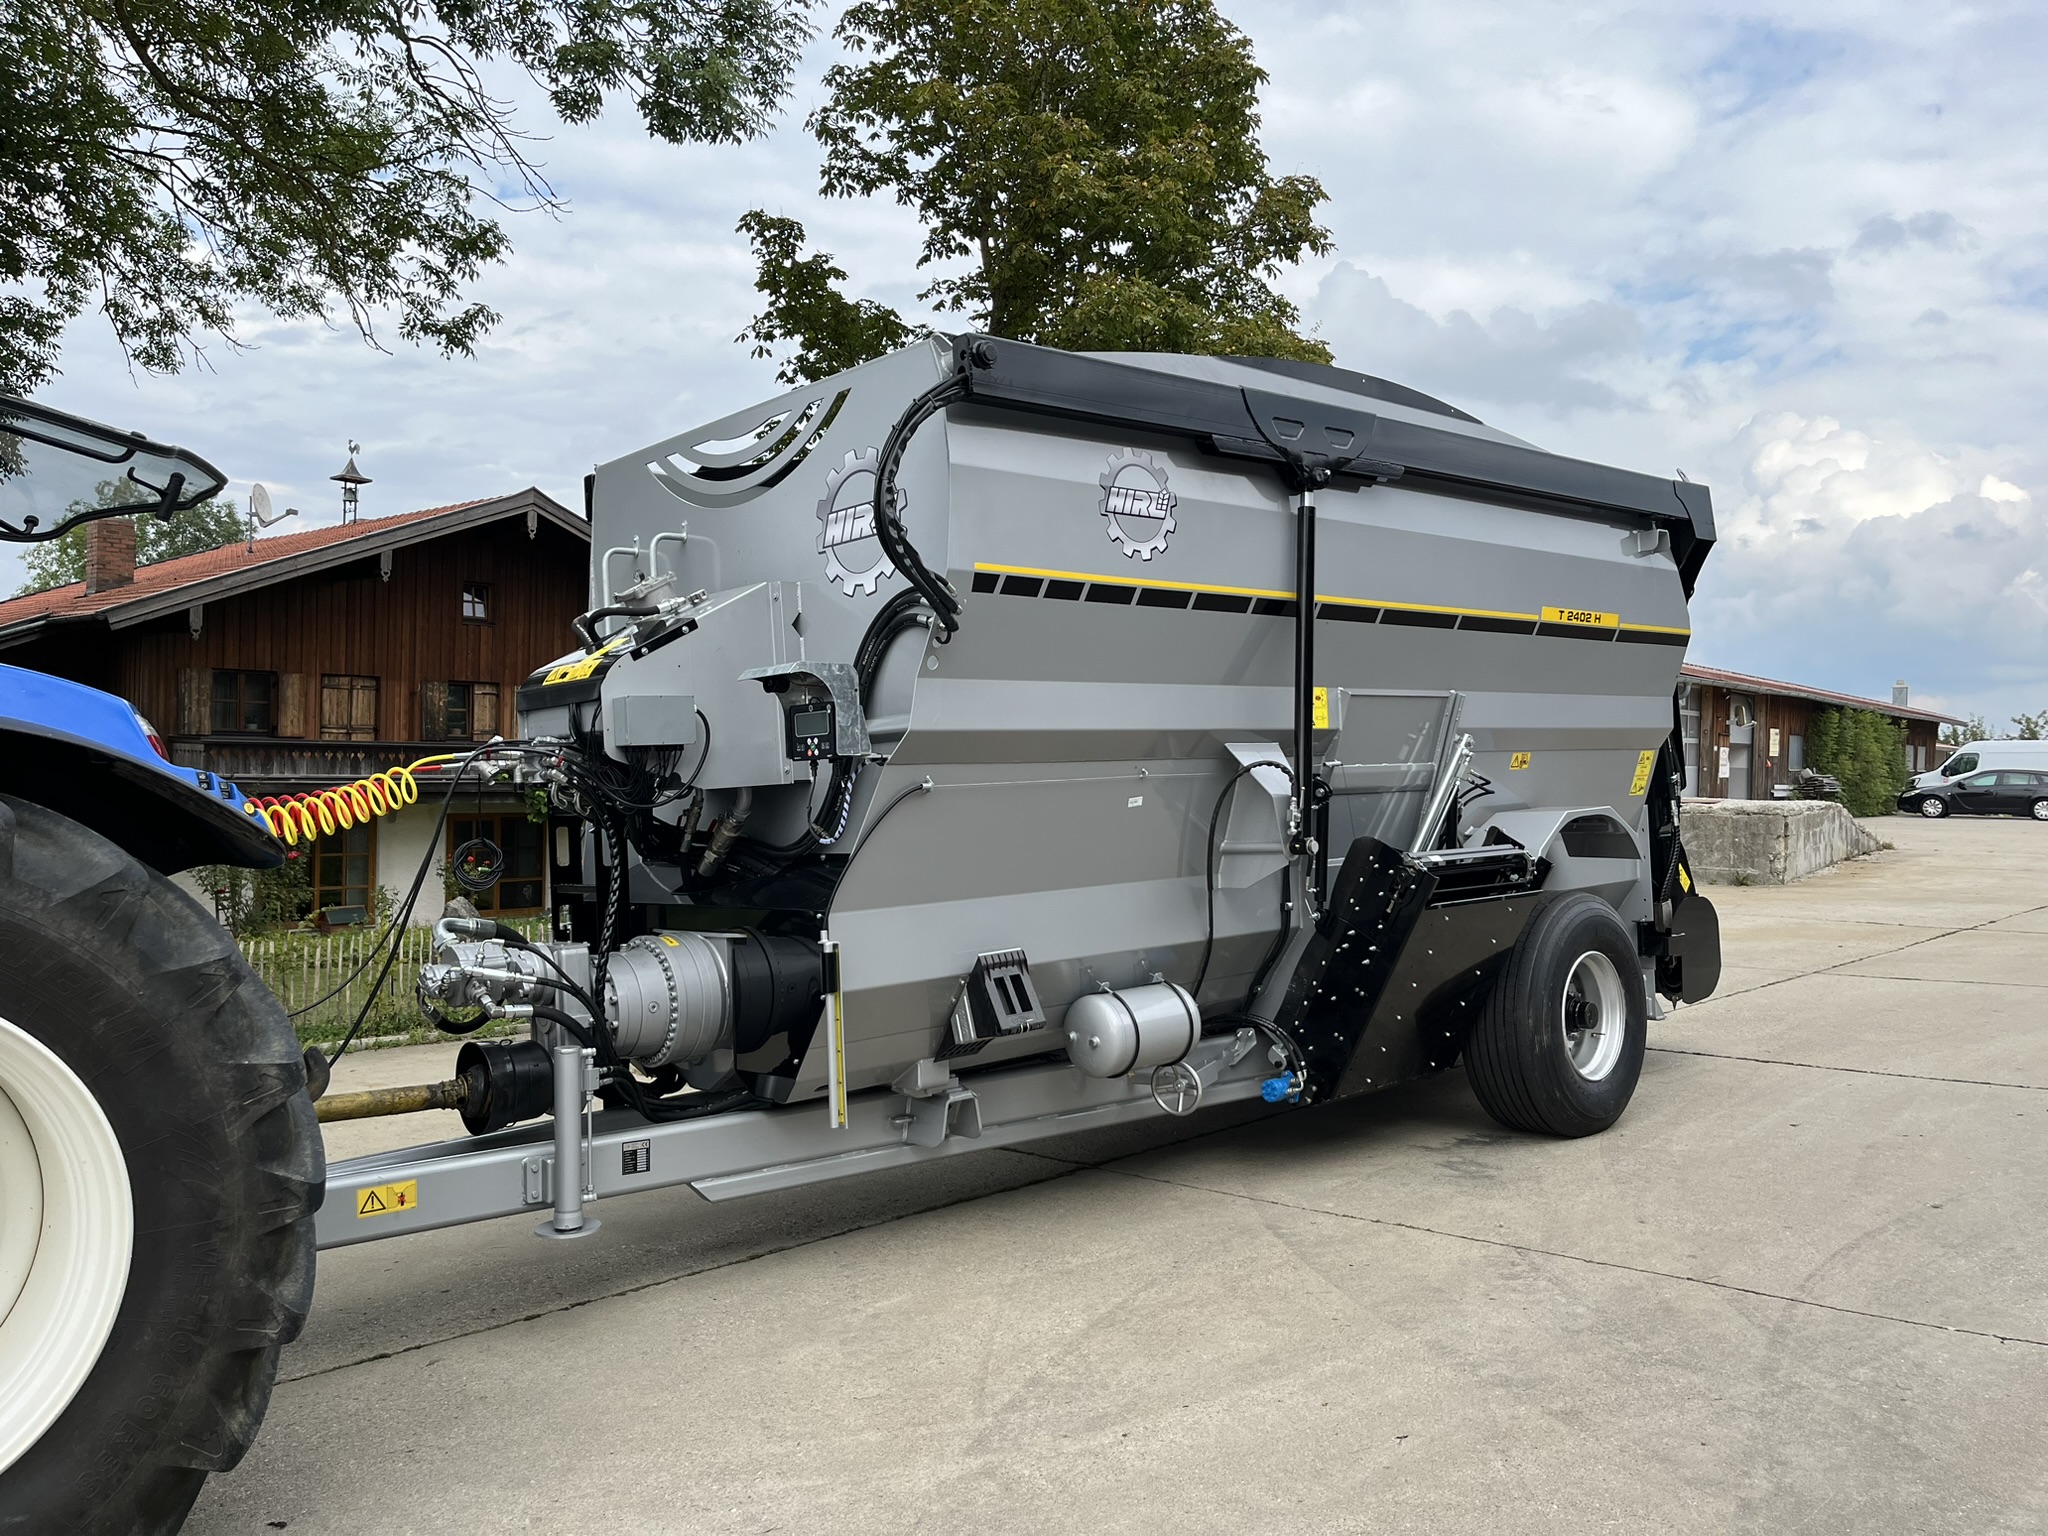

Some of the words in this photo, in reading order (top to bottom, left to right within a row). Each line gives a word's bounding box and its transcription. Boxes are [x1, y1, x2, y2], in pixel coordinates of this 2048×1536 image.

[1105, 486, 1170, 520] HIRL
[823, 501, 878, 548] HIR
[1558, 610, 1565, 621] T
[1567, 611, 1592, 623] 2402
[1594, 613, 1602, 624] H
